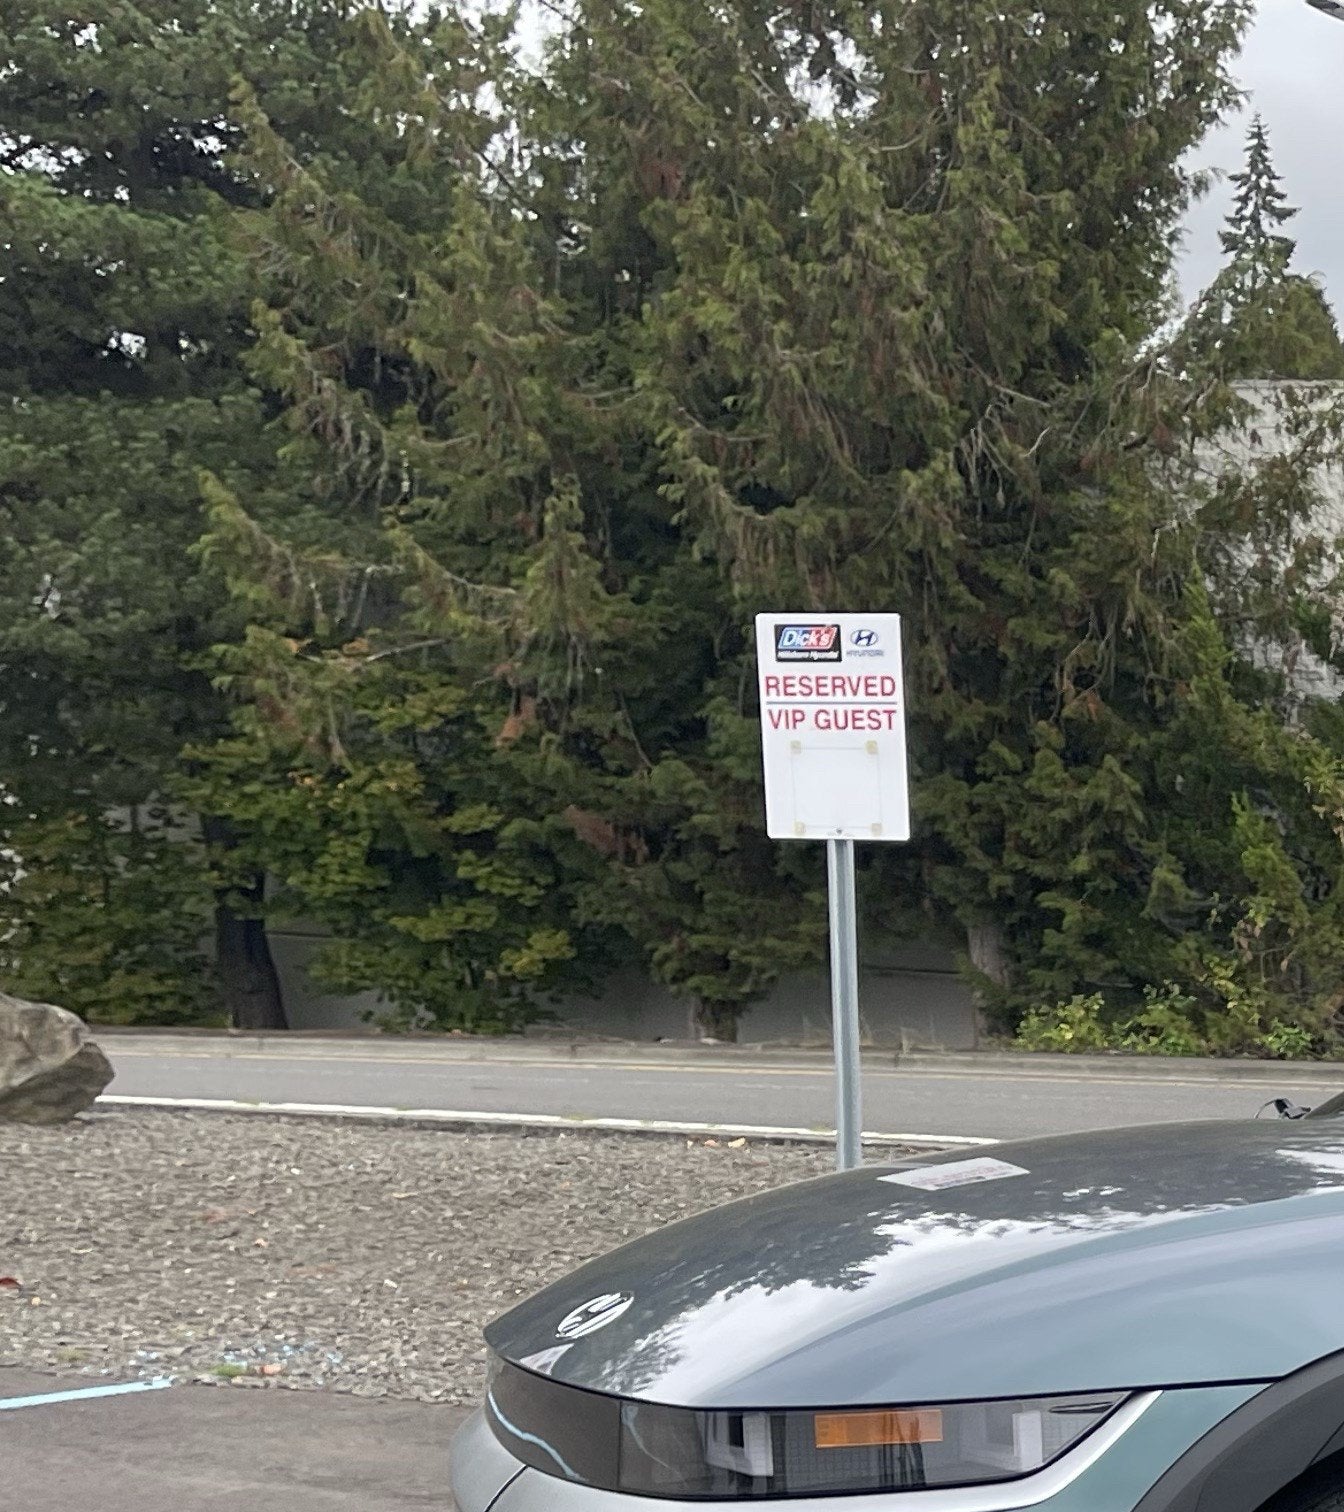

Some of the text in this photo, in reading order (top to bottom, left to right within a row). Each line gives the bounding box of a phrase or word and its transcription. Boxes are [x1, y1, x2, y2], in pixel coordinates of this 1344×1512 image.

[765, 676, 896, 697] RESERVED
[768, 709, 897, 731] VIP GUEST
